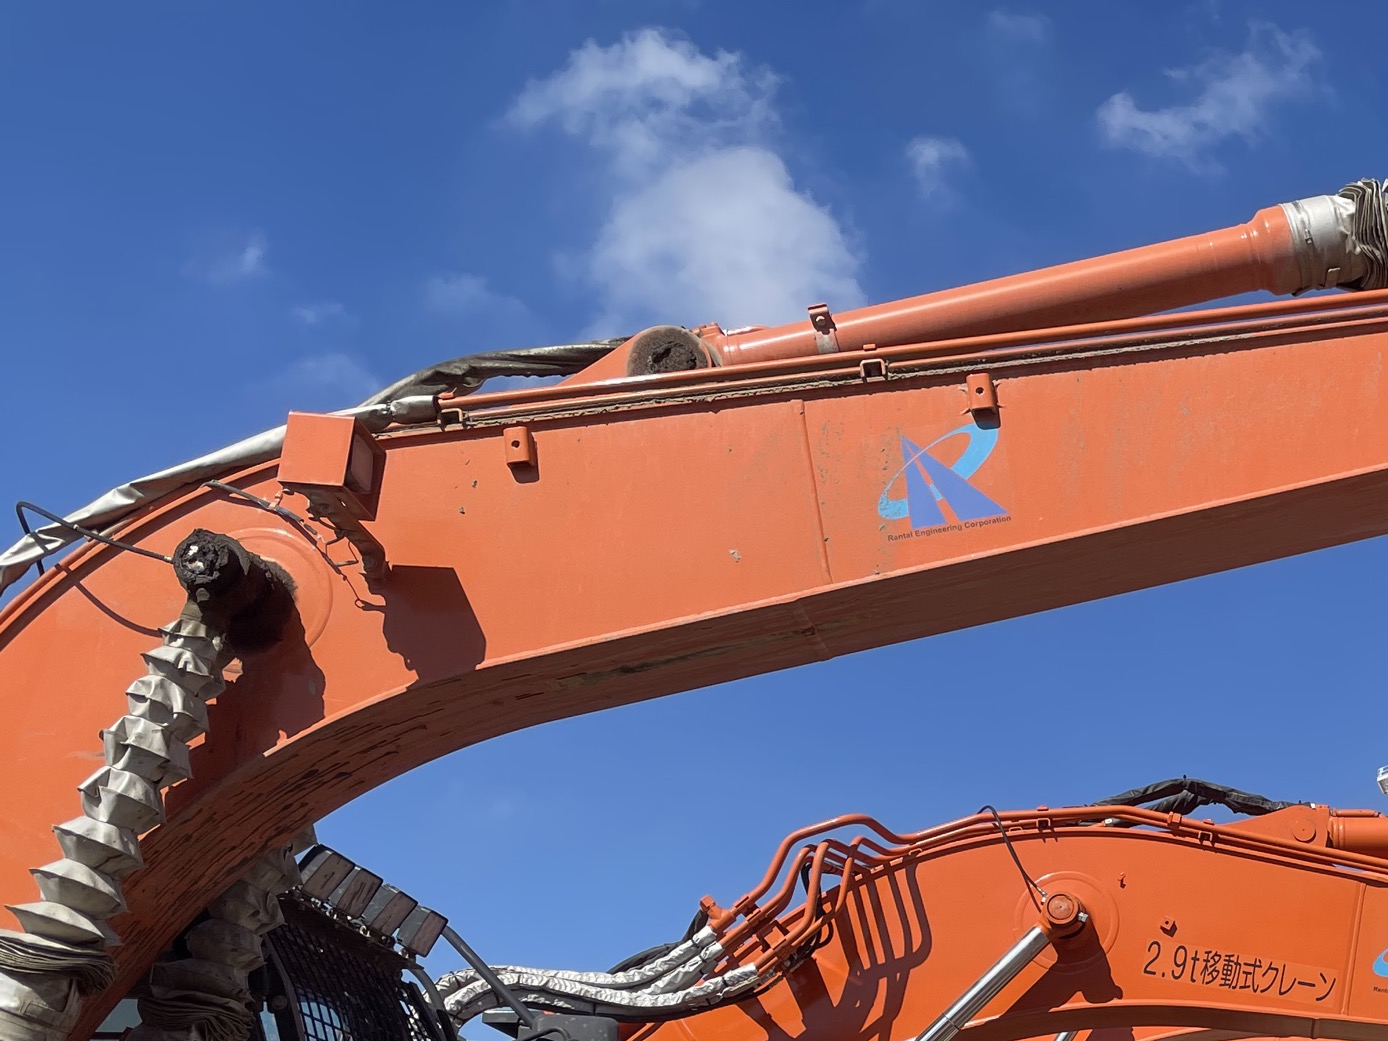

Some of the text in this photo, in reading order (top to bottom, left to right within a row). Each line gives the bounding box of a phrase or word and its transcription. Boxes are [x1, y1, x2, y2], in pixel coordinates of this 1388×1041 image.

[887, 515, 1012, 542] Rental Engineering Corporation
[1143, 940, 1337, 1002] 2.9t移動式クレーン
